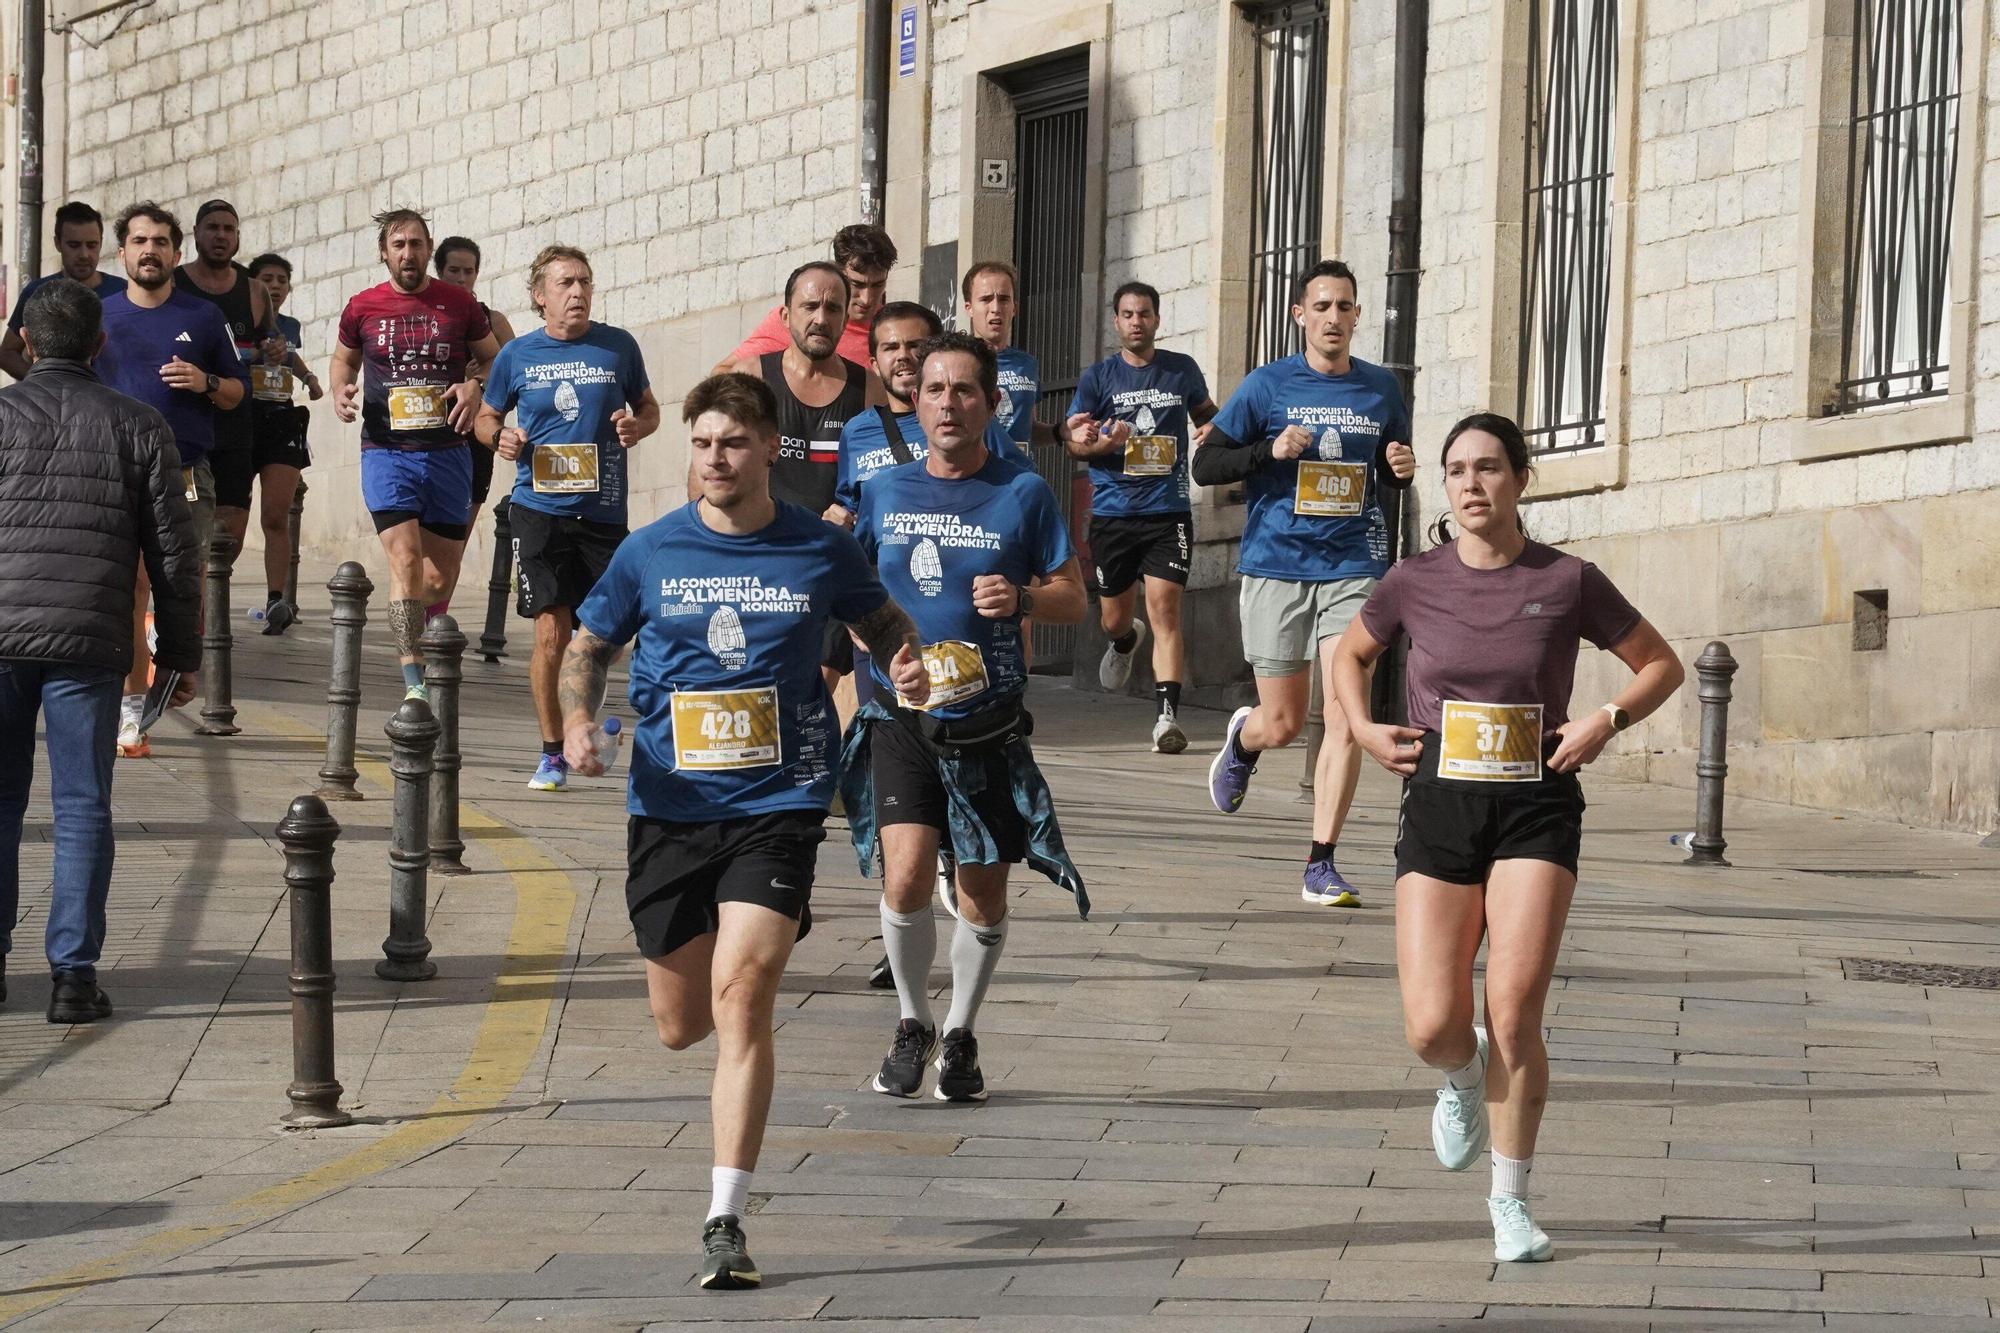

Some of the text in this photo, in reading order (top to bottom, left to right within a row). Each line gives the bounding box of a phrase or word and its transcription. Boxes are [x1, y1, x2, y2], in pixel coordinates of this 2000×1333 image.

[536, 361, 586, 372] CONQUISTA
[538, 367, 604, 381] ALMENDRA
[575, 376, 616, 385] KONKISTA
[407, 377, 427, 386] Vital
[1121, 389, 1159, 399] CONQUISTA
[1124, 392, 1174, 406] ALMENDRA
[404, 397, 433, 413] 338
[1300, 407, 1353, 416] CONQUISTA
[1302, 414, 1371, 426] ALMENDRA
[1341, 426, 1380, 436] KONKISTA
[781, 436, 806, 449] Dan
[1143, 446, 1160, 460] 62
[549, 456, 579, 474] 706
[1316, 476, 1351, 496] 469
[884, 512, 960, 524] LA CONQUISTA
[894, 522, 984, 538] ALMENDRA
[940, 537, 1000, 550] KONKISTA
[661, 576, 761, 588] LA CONQUISTA
[682, 587, 792, 602] ALMENDRA
[669, 602, 703, 615] Edición
[741, 602, 811, 612] KONKISTA
[701, 710, 751, 740] 428
[1477, 723, 1508, 752] 37
[708, 742, 746, 750] ALEJANDRO
